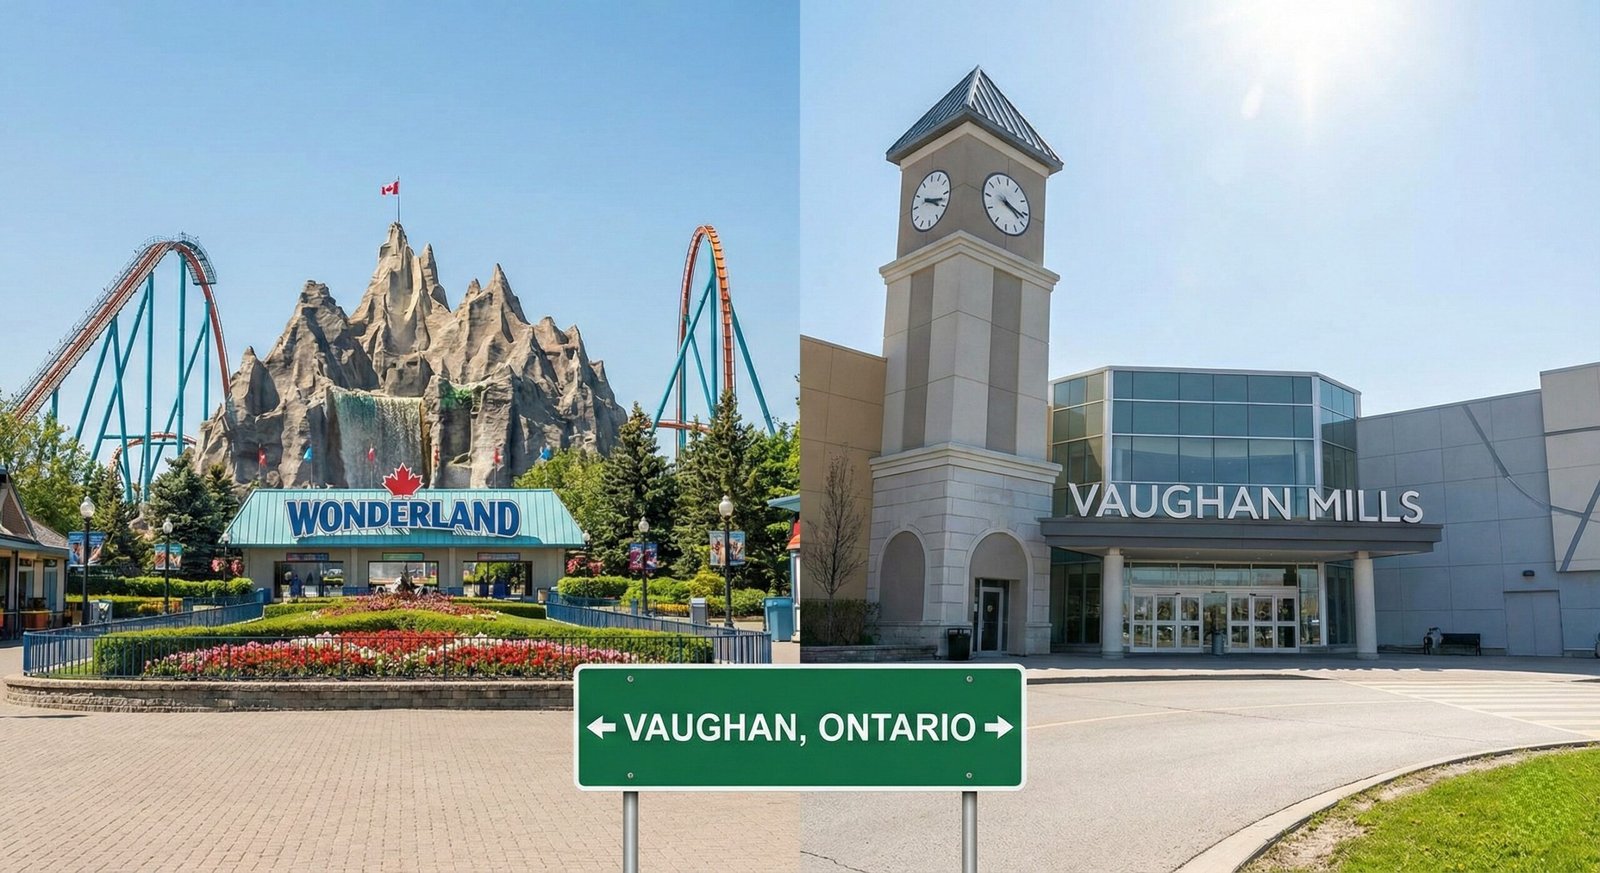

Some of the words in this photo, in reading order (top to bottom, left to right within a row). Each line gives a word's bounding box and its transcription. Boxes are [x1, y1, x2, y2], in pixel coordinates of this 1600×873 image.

[286, 499, 521, 538] WONDERLAND
[1069, 482, 1292, 520] VAUGHAN
[1308, 488, 1424, 524] MILLS
[623, 713, 807, 747] VAUGHAN,
[818, 713, 977, 742] ONTARIO
